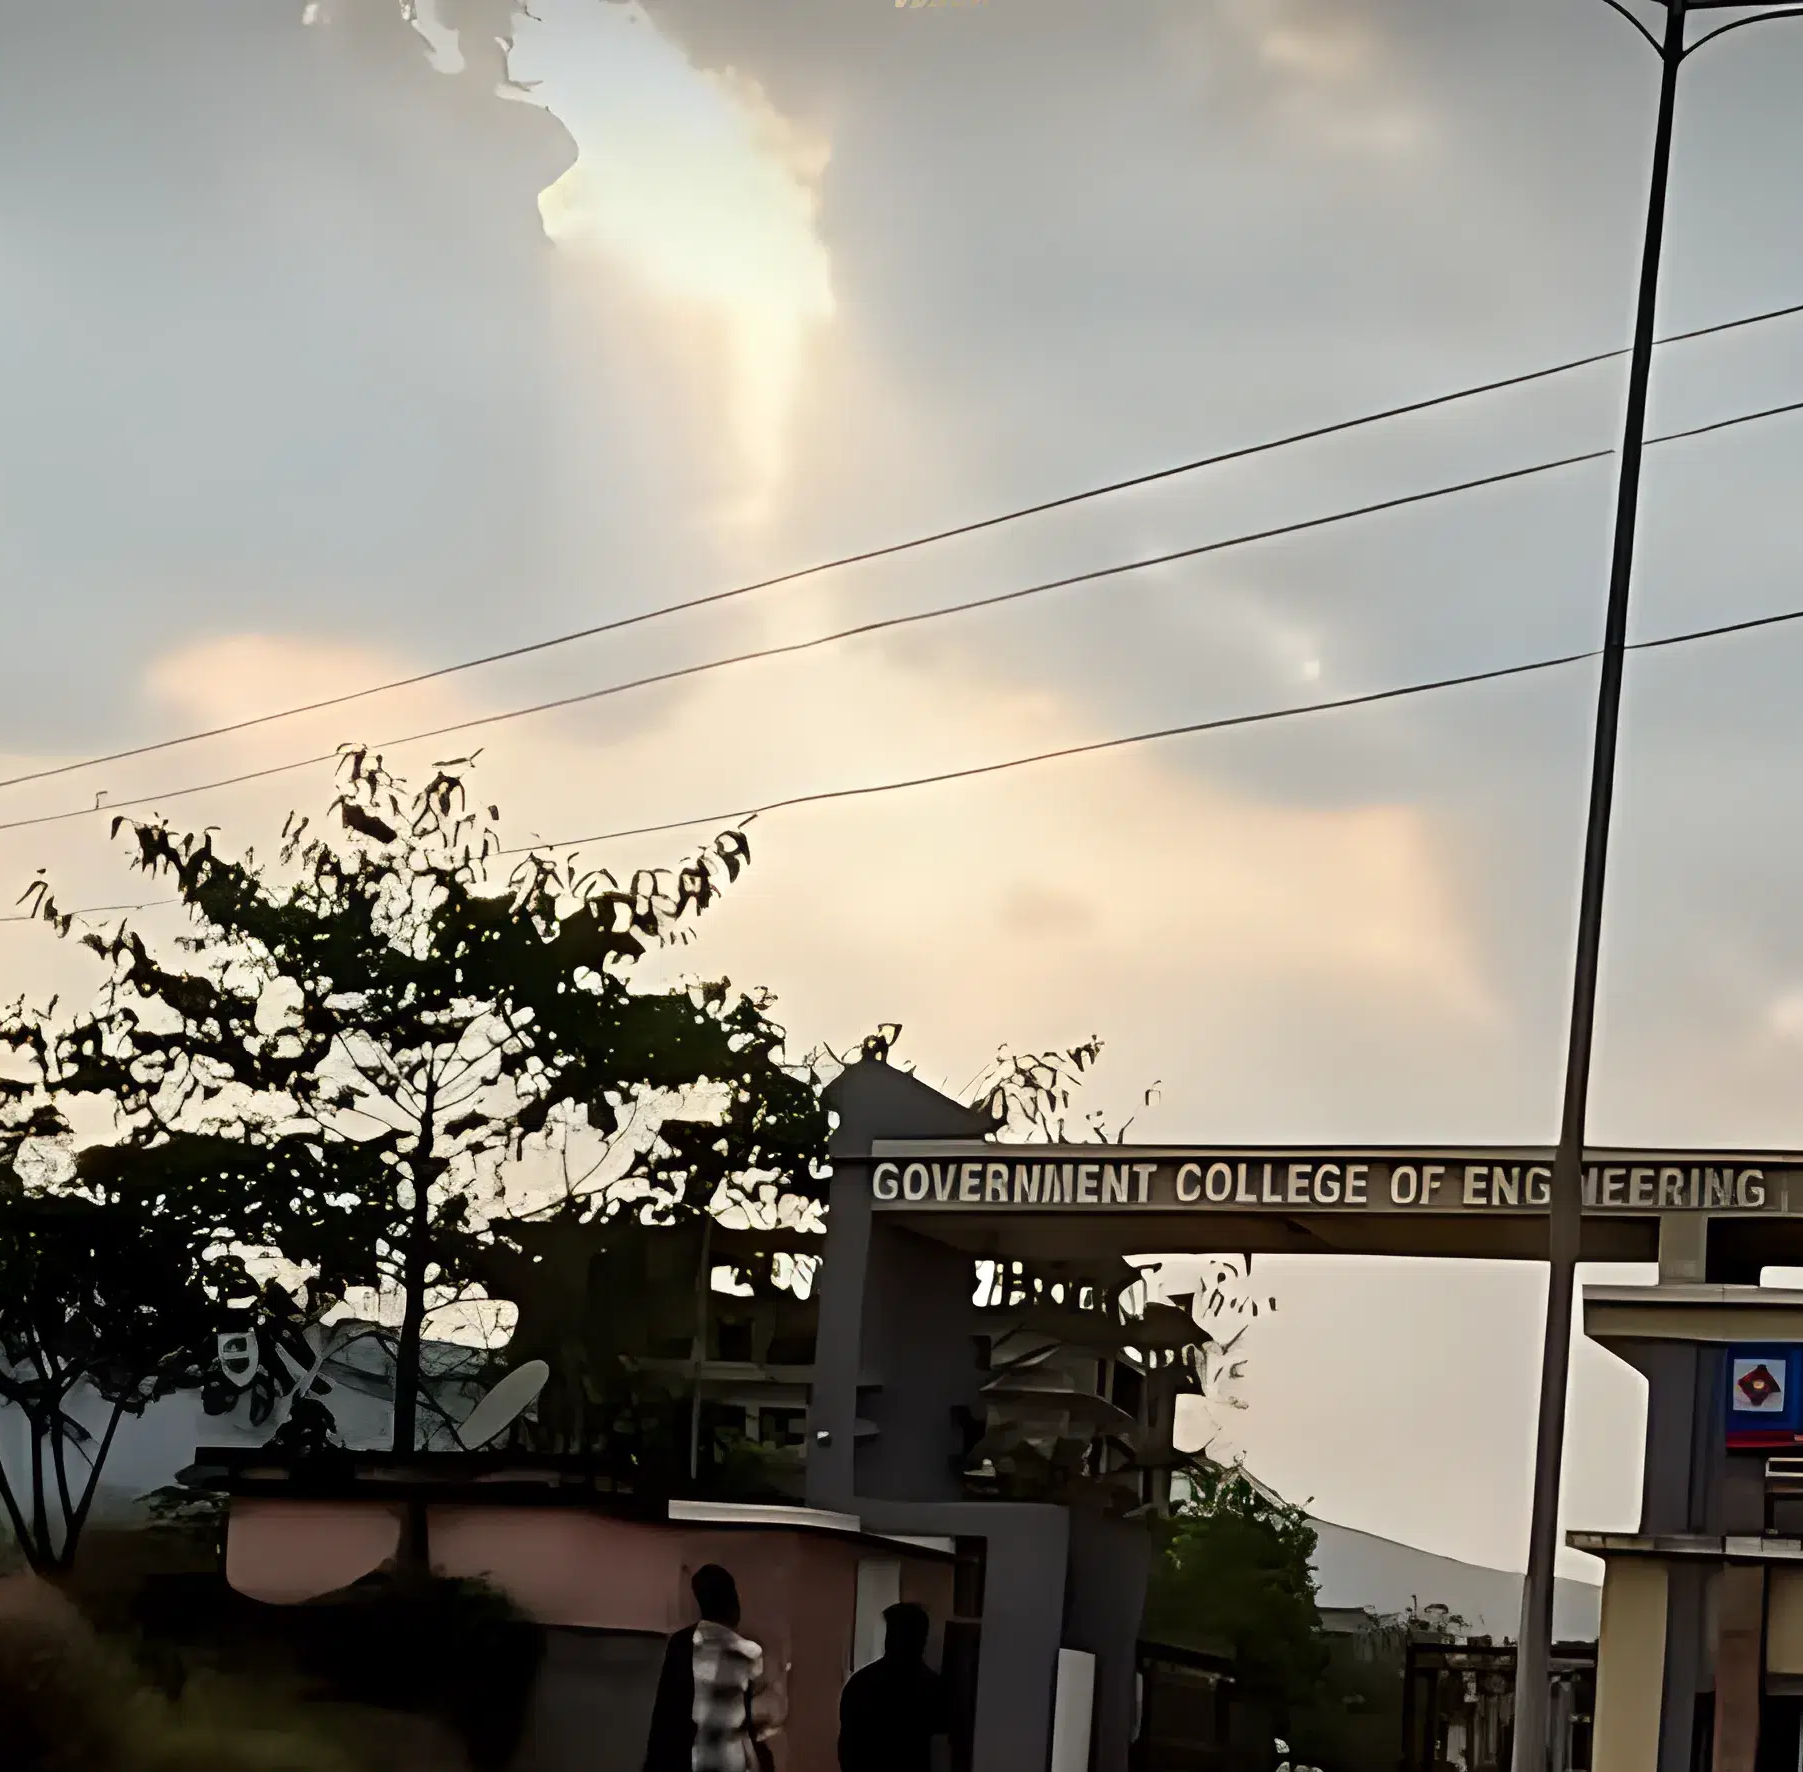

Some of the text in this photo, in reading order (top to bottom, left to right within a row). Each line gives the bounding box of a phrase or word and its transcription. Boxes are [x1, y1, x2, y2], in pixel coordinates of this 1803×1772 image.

[872, 1162, 1158, 1203] GOVERNMENT
[1176, 1162, 1369, 1203] COLLEGE
[1390, 1165, 1446, 1204] OF
[1462, 1166, 1765, 1208] ENGNEERING
